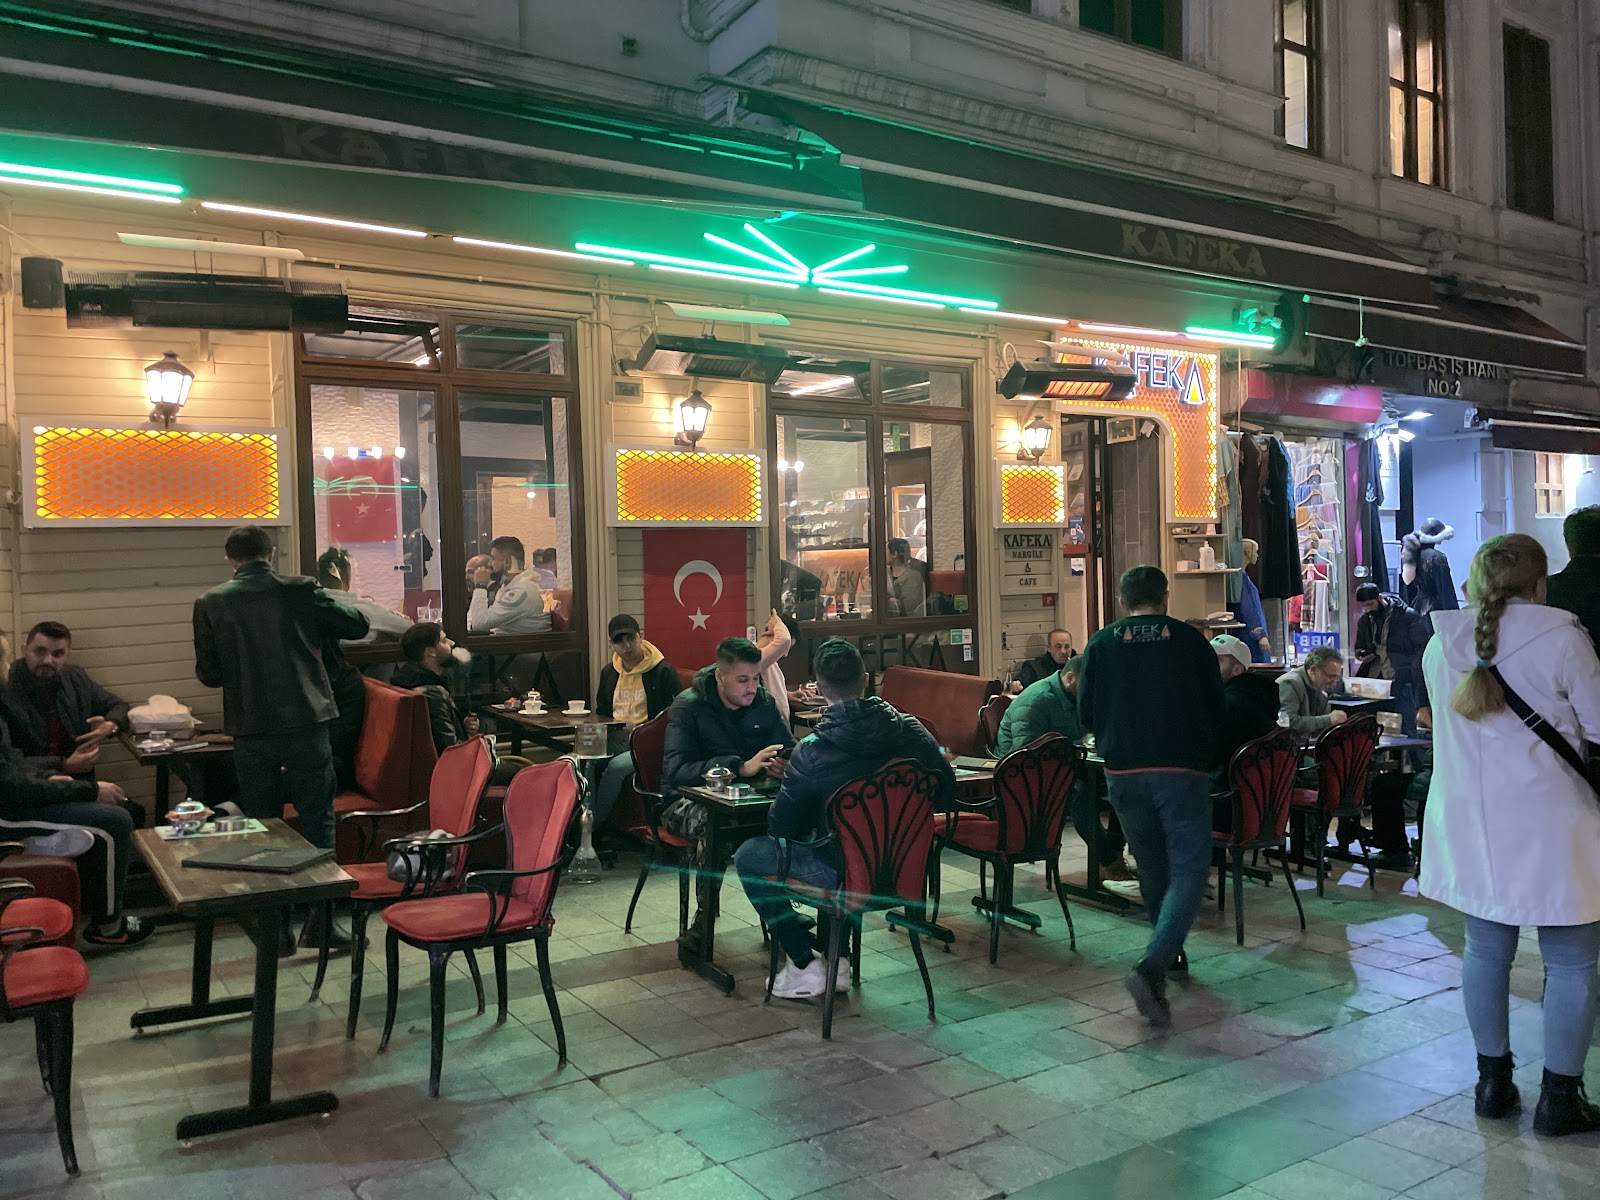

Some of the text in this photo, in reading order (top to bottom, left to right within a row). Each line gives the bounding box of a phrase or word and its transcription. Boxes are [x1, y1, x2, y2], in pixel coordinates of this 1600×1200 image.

[1120, 223, 1267, 276] KAFEKA
[1094, 346, 1206, 405] FEKA
[1004, 534, 1052, 548] KAFEKA
[1024, 562, 1032, 573] &
[1019, 577, 1037, 586] CAFE
[1113, 623, 1171, 640] KAFEKA
